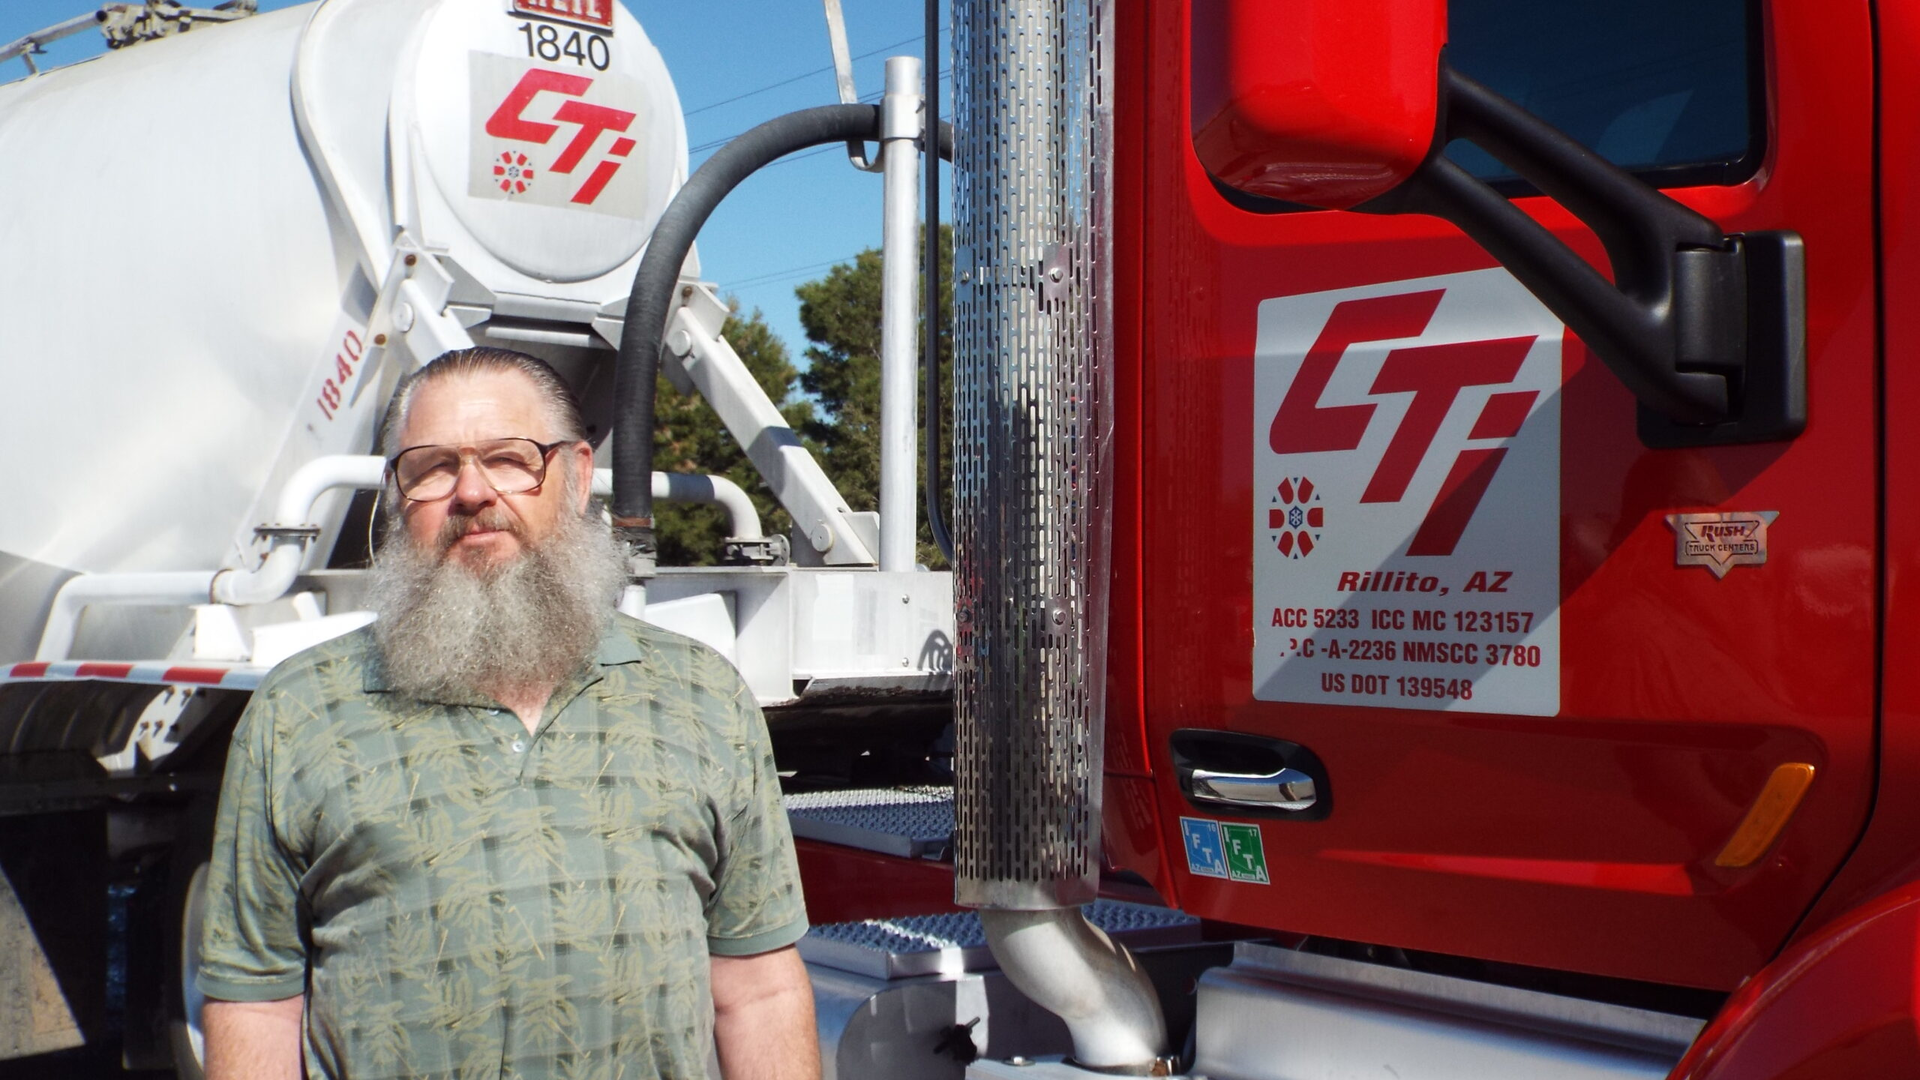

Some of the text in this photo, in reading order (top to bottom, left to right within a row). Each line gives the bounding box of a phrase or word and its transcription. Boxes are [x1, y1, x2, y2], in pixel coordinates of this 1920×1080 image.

[518, 22, 610, 71] 1840
[316, 330, 363, 421] 1840
[1701, 525, 1746, 542] RUSH
[1689, 543, 1755, 552] TRUCK CENTERS
[1337, 571, 1513, 597] Rillito, AZ
[1272, 608, 1534, 634] ACC 5233 ICC MC 123157
[1403, 642, 1478, 664] NMSCC
[1486, 644, 1541, 667] 3780
[1321, 672, 1473, 700] US DOT 139548
[1248, 829, 1258, 837] 17
